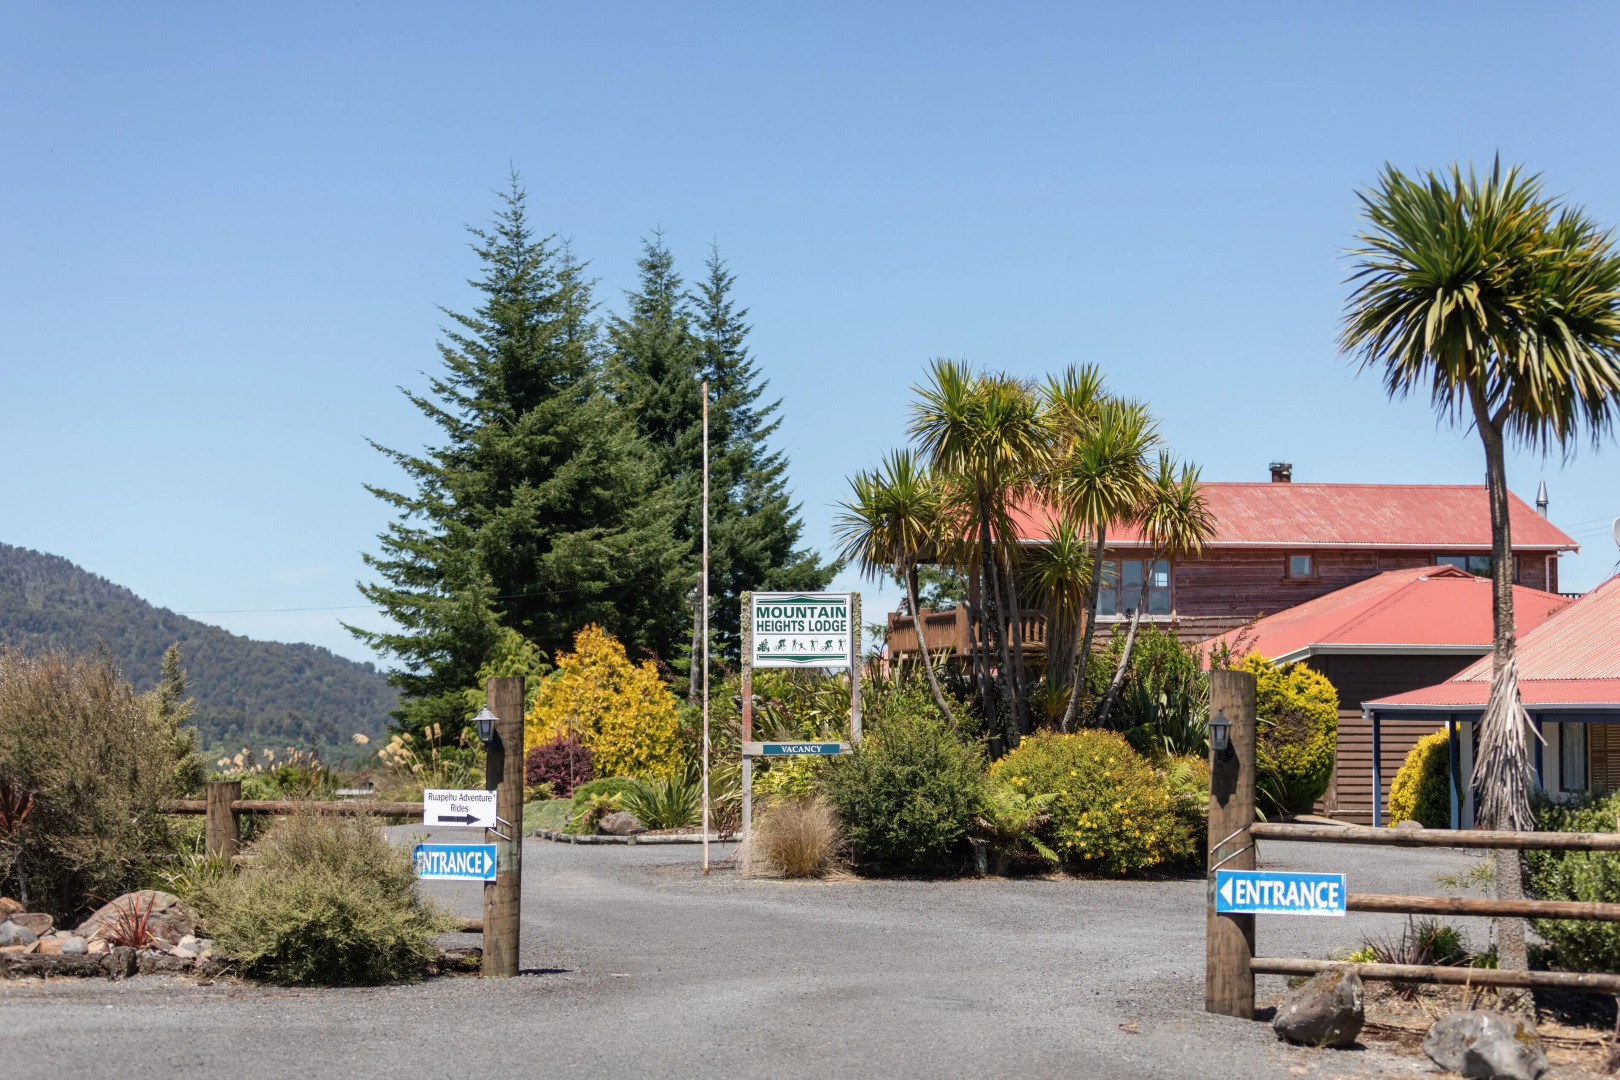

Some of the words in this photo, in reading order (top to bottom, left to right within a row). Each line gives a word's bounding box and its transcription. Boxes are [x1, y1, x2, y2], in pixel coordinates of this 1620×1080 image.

[756, 606, 847, 619] MOUNTAIN
[756, 619, 805, 632] HEIGHTS
[808, 619, 847, 632] LODGE
[781, 745, 822, 753] VACANCY
[428, 792, 457, 802] Ruapehu
[459, 793, 492, 802] Adventure
[450, 803, 469, 812] Rides
[1235, 879, 1340, 908] ENTRANCE
